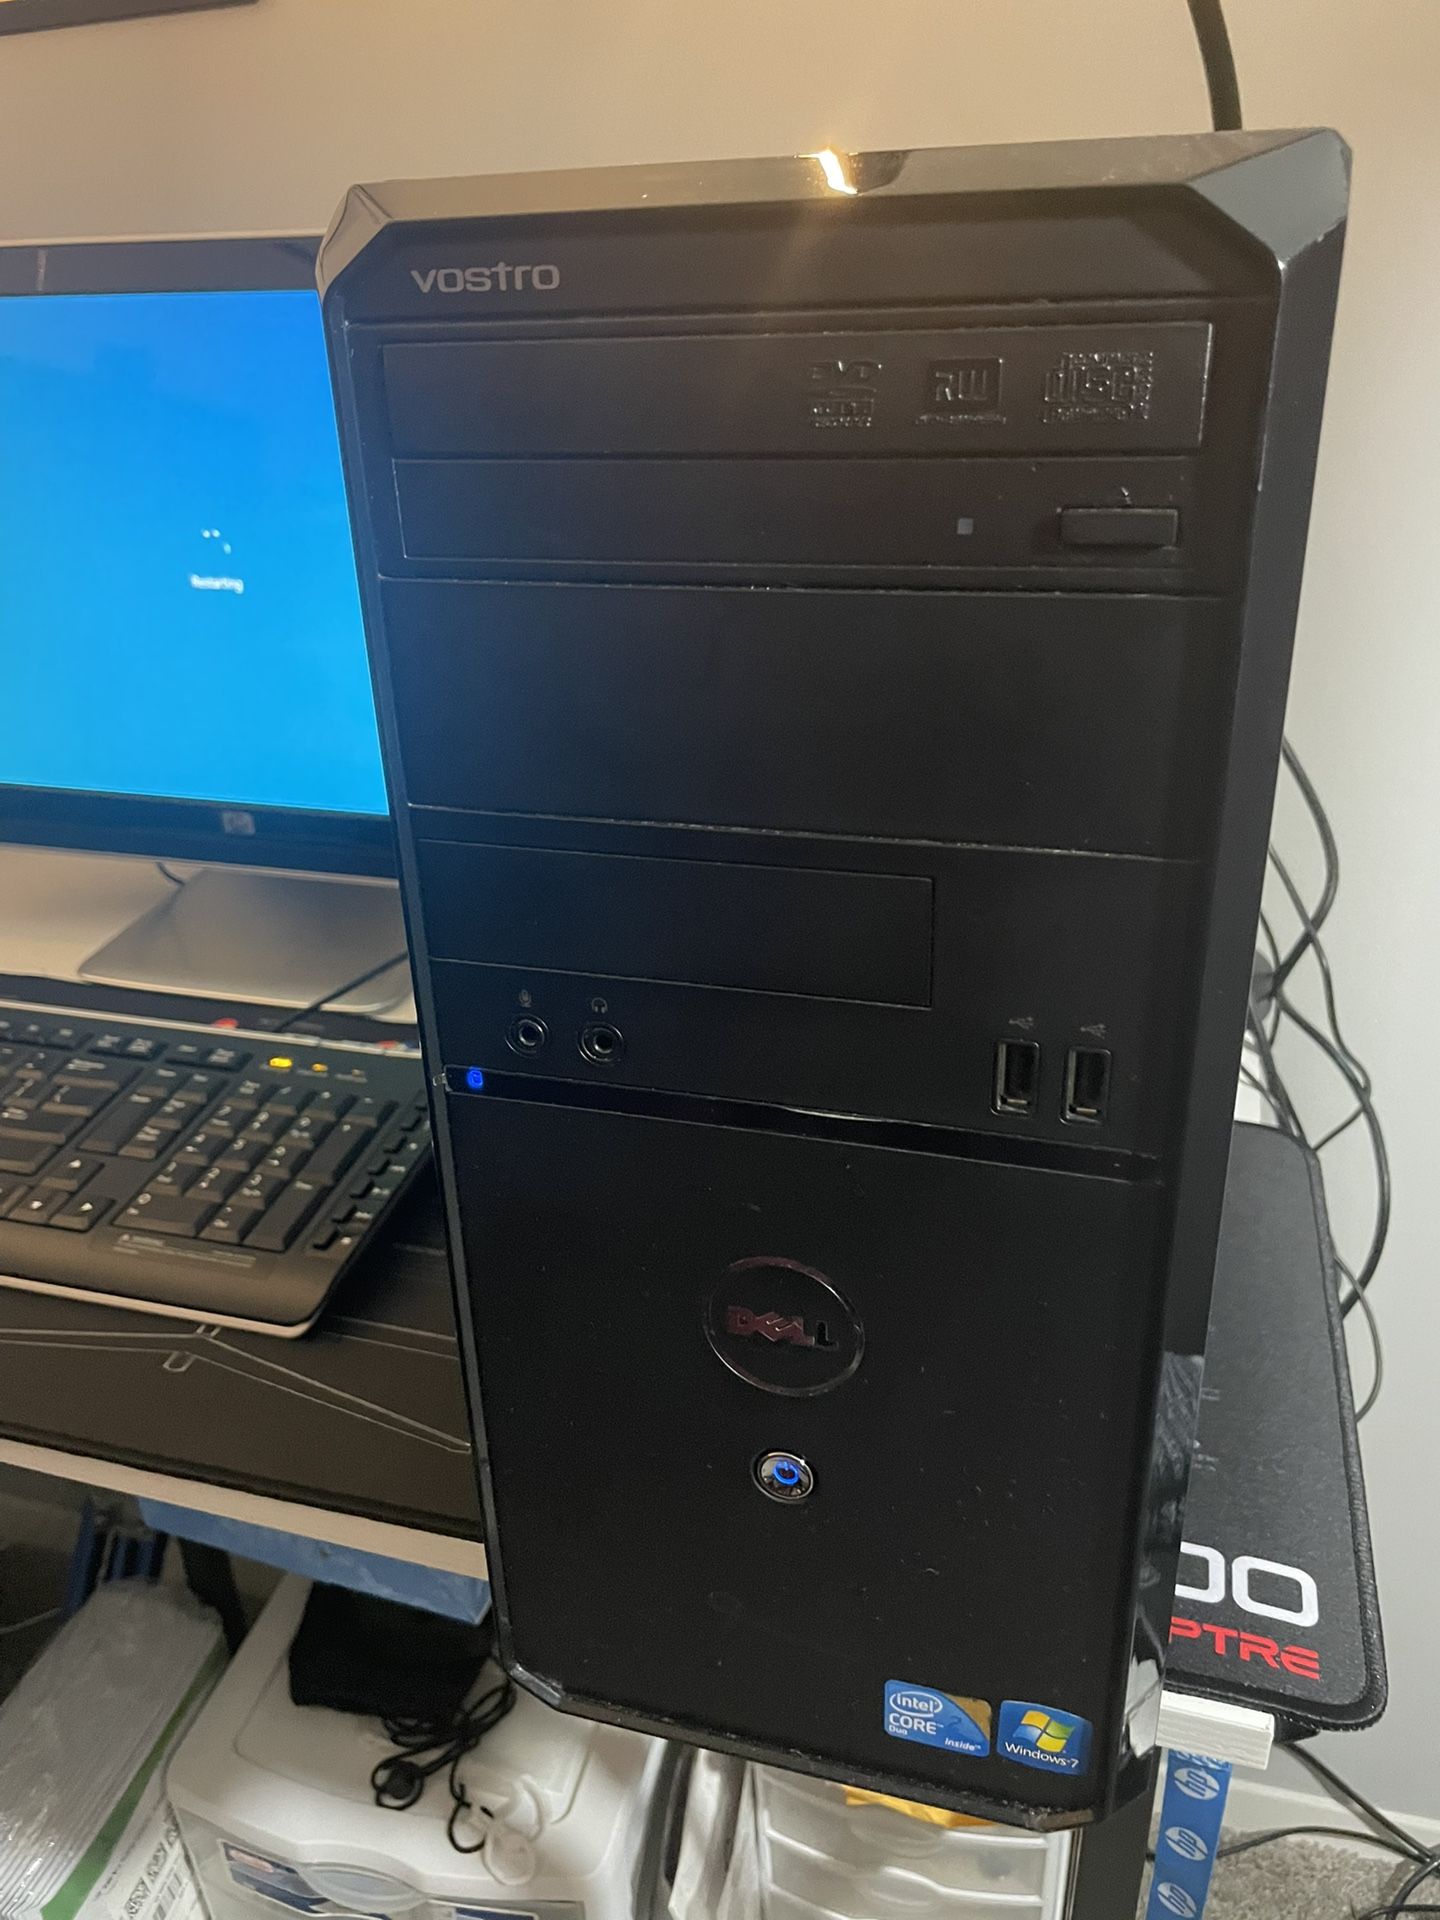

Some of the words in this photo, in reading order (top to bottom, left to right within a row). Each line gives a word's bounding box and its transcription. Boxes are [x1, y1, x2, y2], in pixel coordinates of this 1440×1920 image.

[410, 262, 560, 293] vostro
[728, 1306, 839, 1348] DELL
[897, 1693, 933, 1713] intel
[889, 1713, 937, 1735] CORE
[1005, 1742, 1066, 1766] Windows
